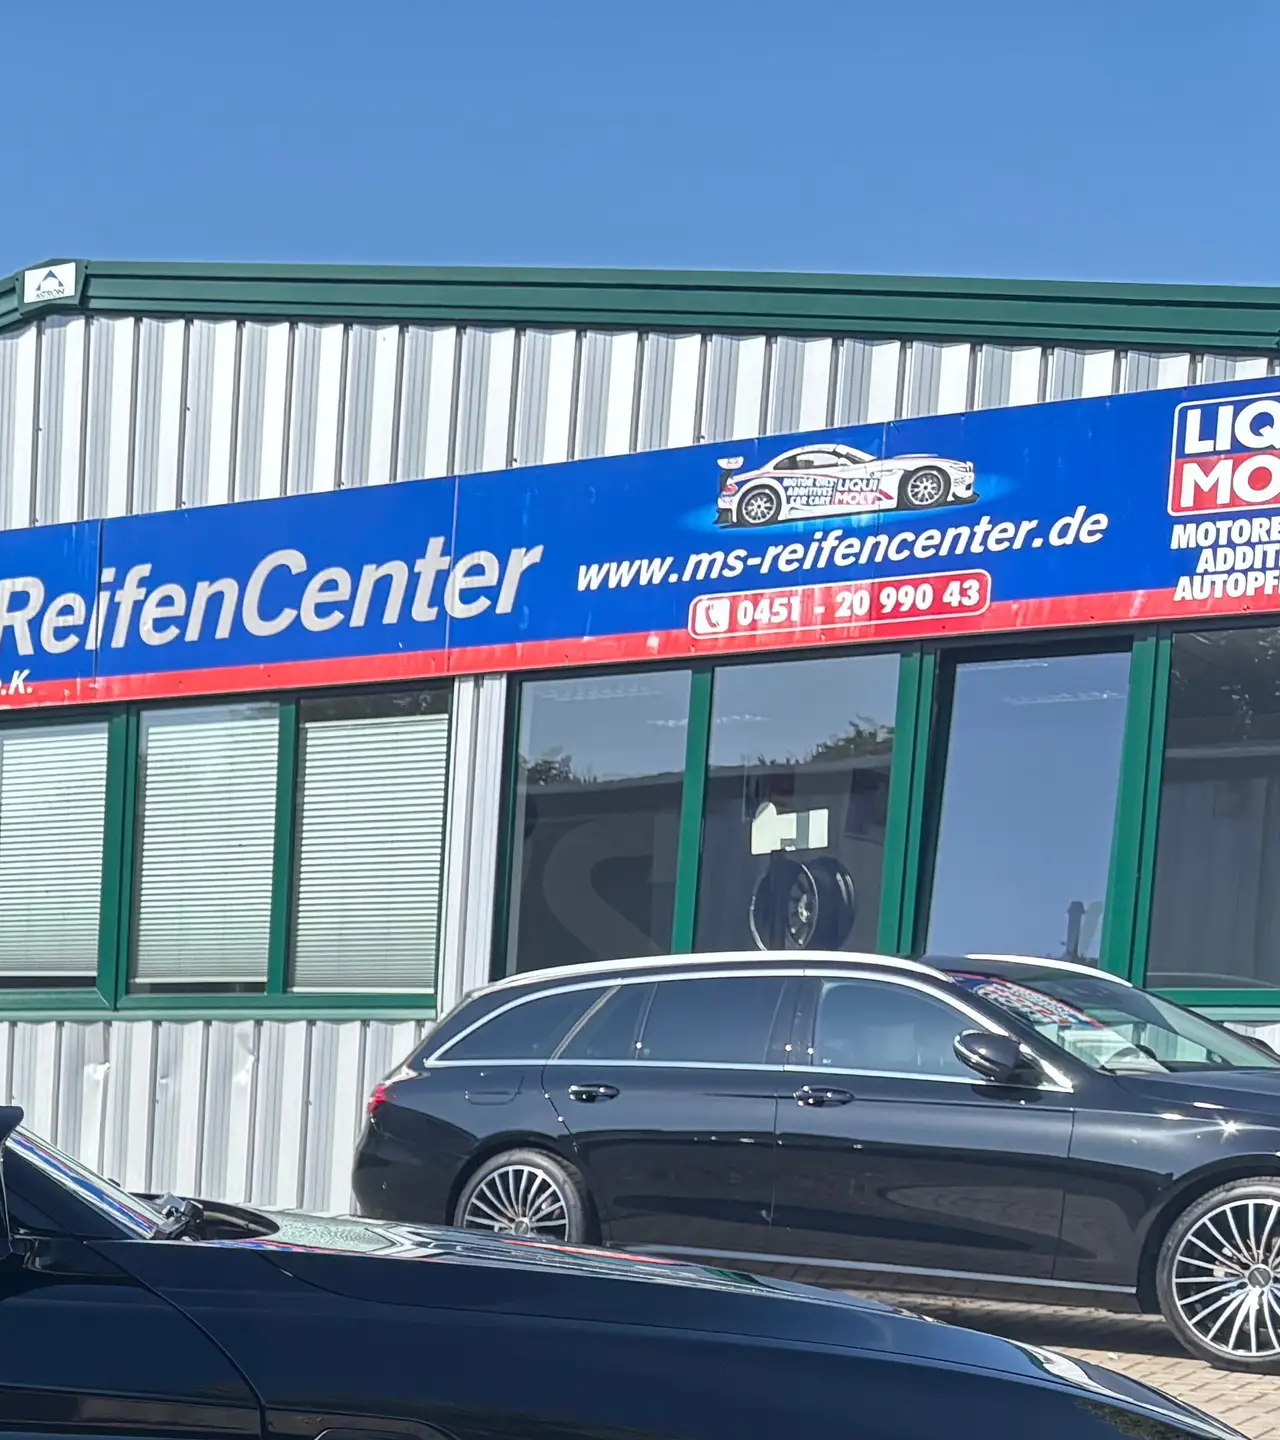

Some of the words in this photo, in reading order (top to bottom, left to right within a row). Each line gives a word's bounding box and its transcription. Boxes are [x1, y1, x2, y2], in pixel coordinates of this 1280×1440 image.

[835, 491, 876, 505] MOLY
[837, 478, 879, 491] LIQUI
[576, 505, 1110, 591] www.ms-reifencenter.de
[1196, 543, 1280, 573] ADDIT
[1173, 569, 1280, 602] AUTOPF
[737, 596, 800, 627] 0451
[835, 589, 872, 619] 20
[880, 583, 934, 614] 990
[942, 578, 980, 608] 43
